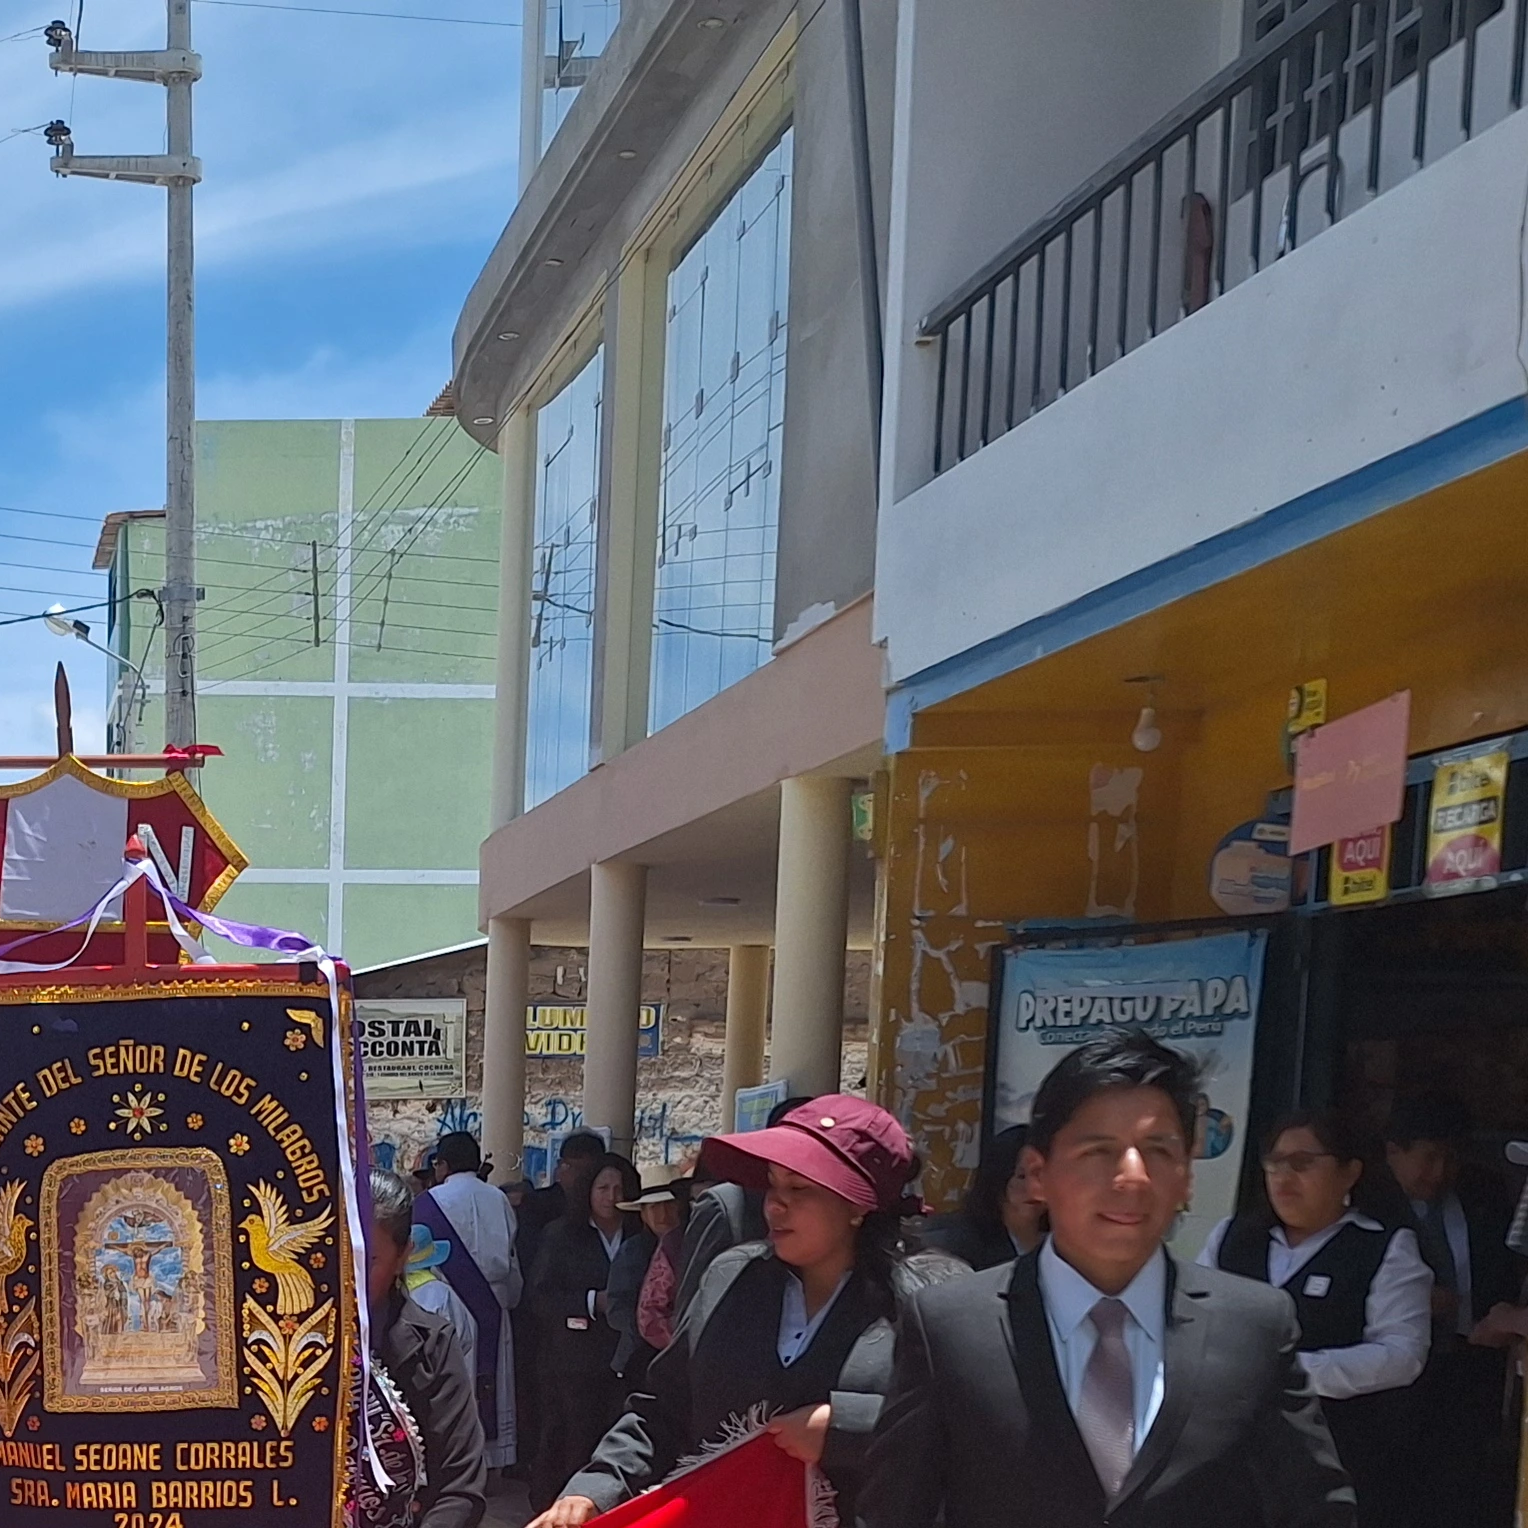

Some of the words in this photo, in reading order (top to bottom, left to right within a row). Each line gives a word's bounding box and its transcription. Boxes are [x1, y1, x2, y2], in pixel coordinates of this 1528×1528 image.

[136, 823, 195, 904] N
[355, 1020, 441, 1040] OSTAL
[358, 1040, 441, 1057] CCONTA
[36, 1058, 82, 1098] DEL
[87, 1039, 165, 1077] SEÑOR
[173, 1048, 208, 1082] DE
[210, 1061, 258, 1105] LOS
[250, 1093, 331, 1204] MILAGROS
[176, 1440, 294, 1471] CORRALES
[10, 1477, 60, 1507] SRA.
[65, 1481, 137, 1509] MARIA
[152, 1480, 253, 1508] BARRIOS
[272, 1480, 298, 1507] L.
